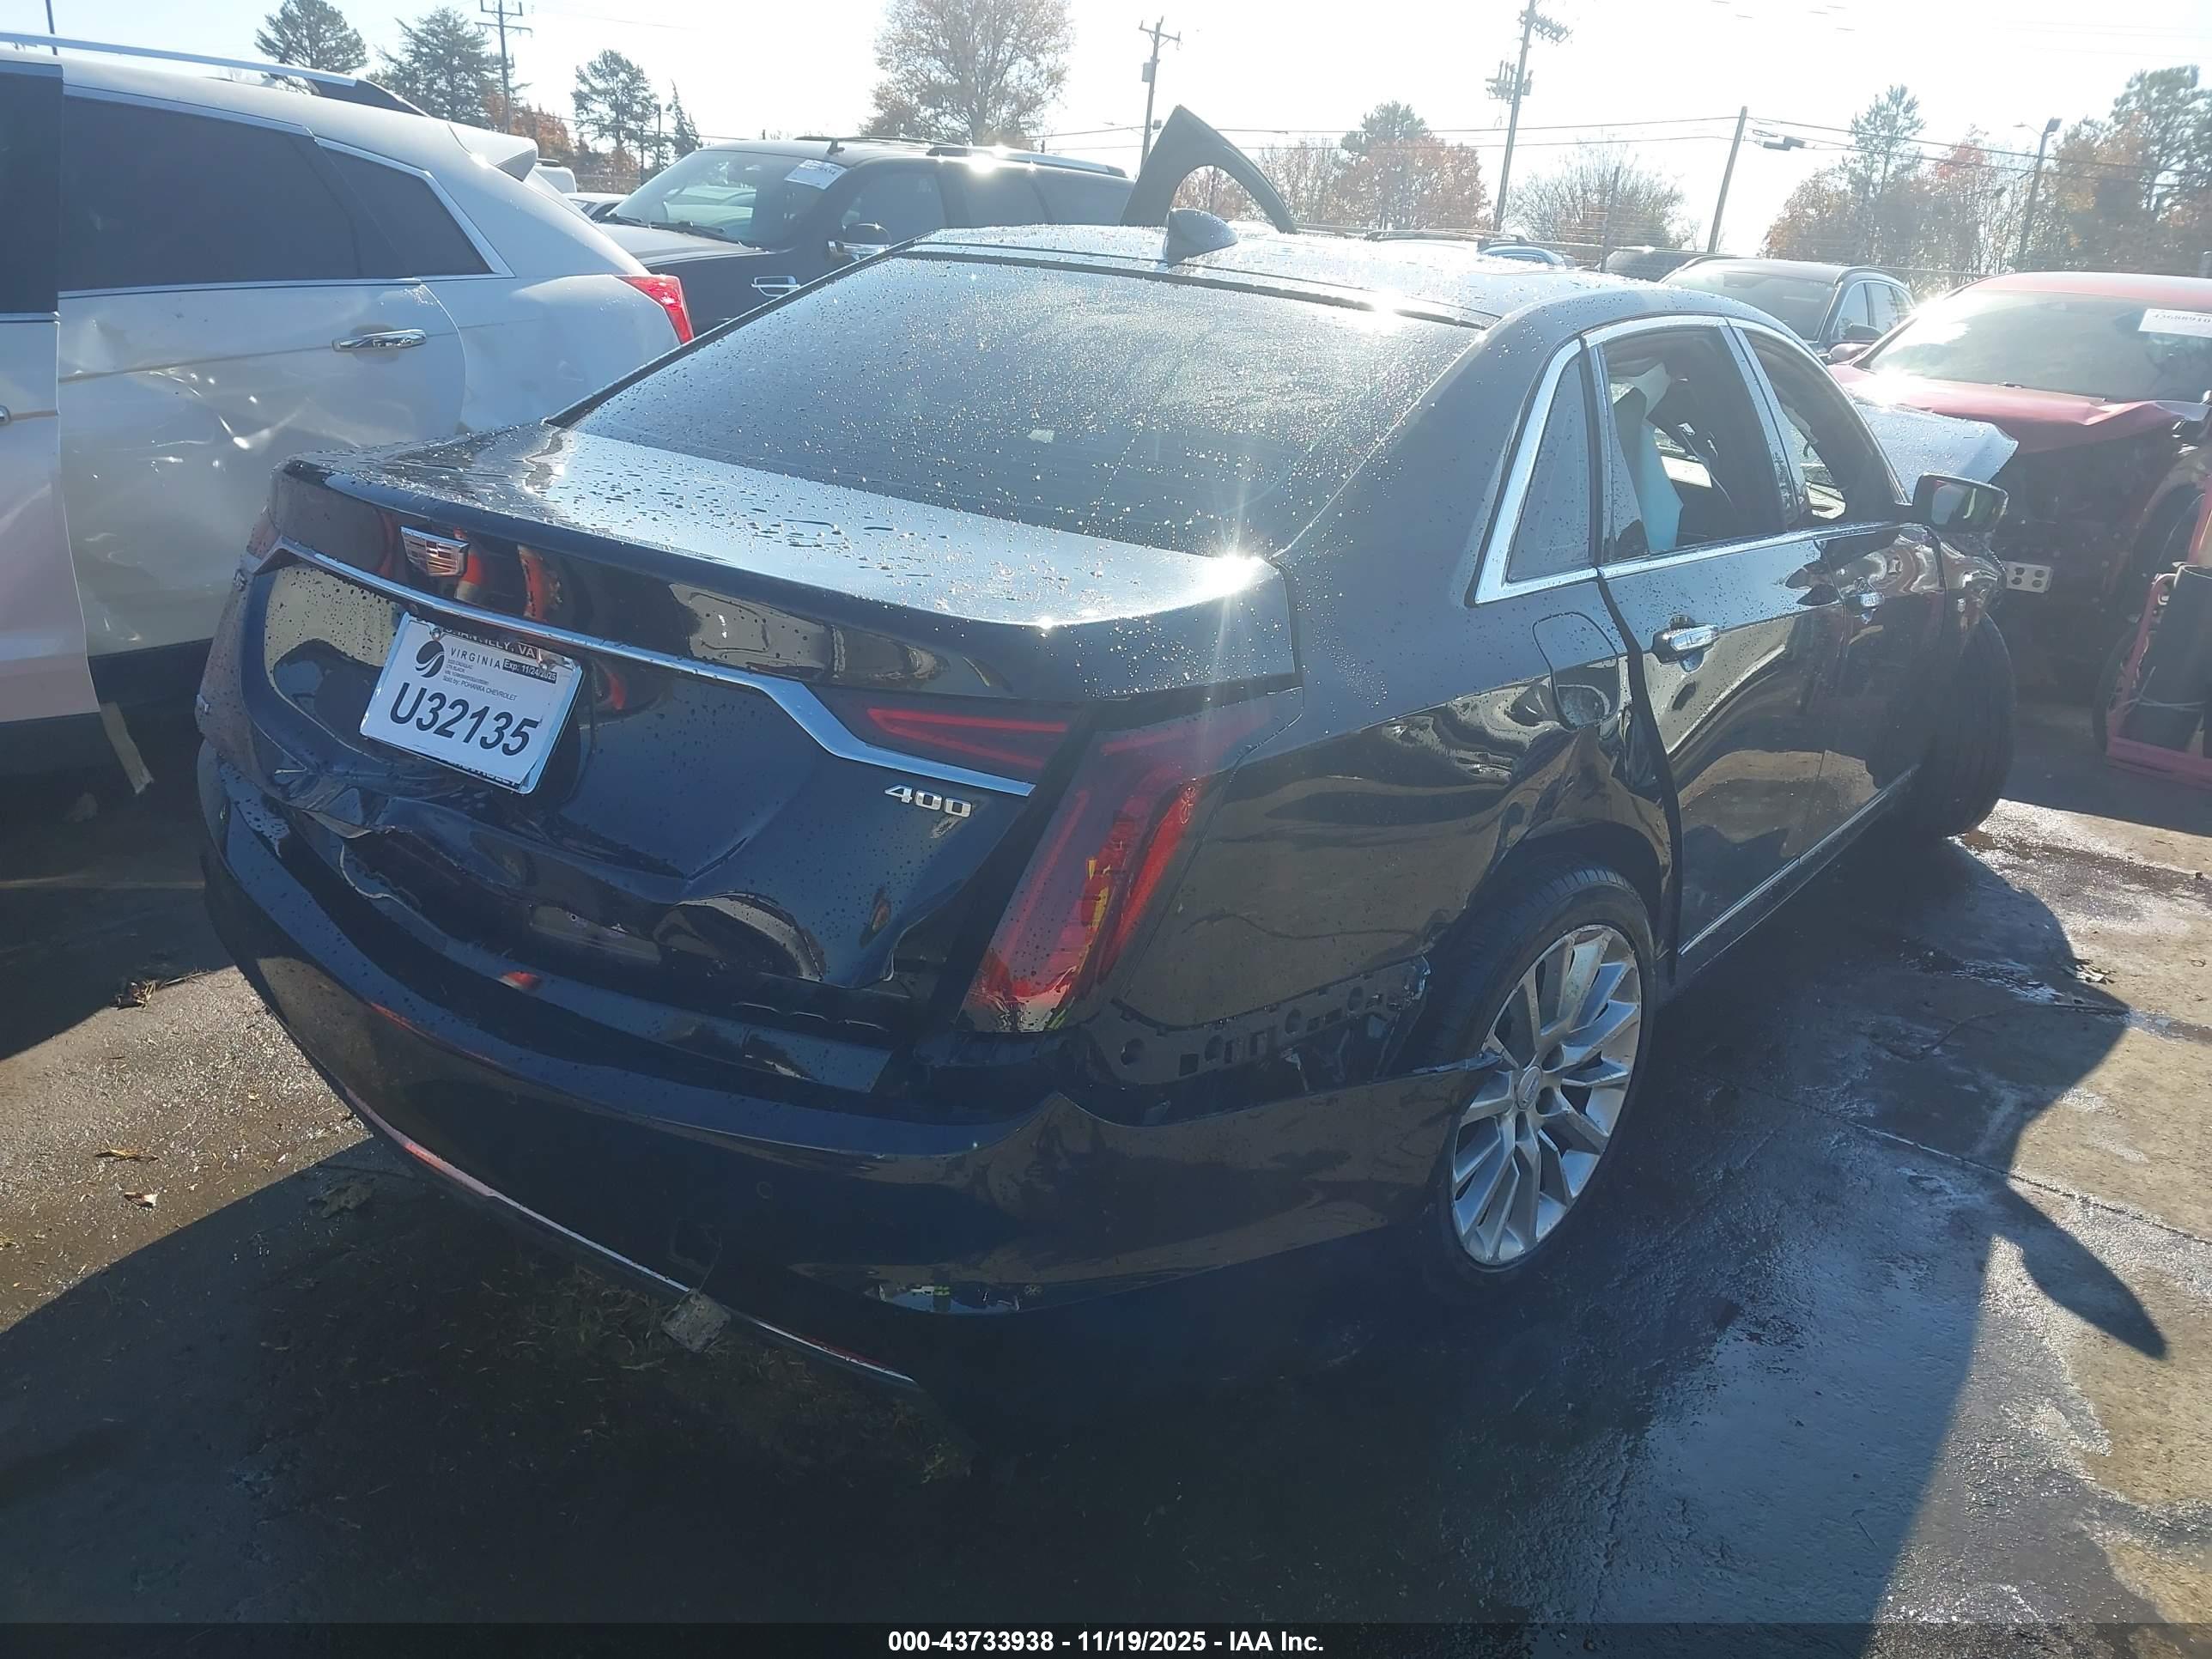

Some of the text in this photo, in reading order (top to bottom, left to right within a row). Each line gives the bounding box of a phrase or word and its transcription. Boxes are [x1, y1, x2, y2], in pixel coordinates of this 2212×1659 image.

[451, 647, 501, 670] VIRGINIA
[517, 644, 536, 659] VA
[504, 659, 556, 681] Exp: 11/24/2025
[485, 687, 518, 702] CHEVROLET
[390, 683, 539, 756] U32135
[884, 784, 972, 817] 400
